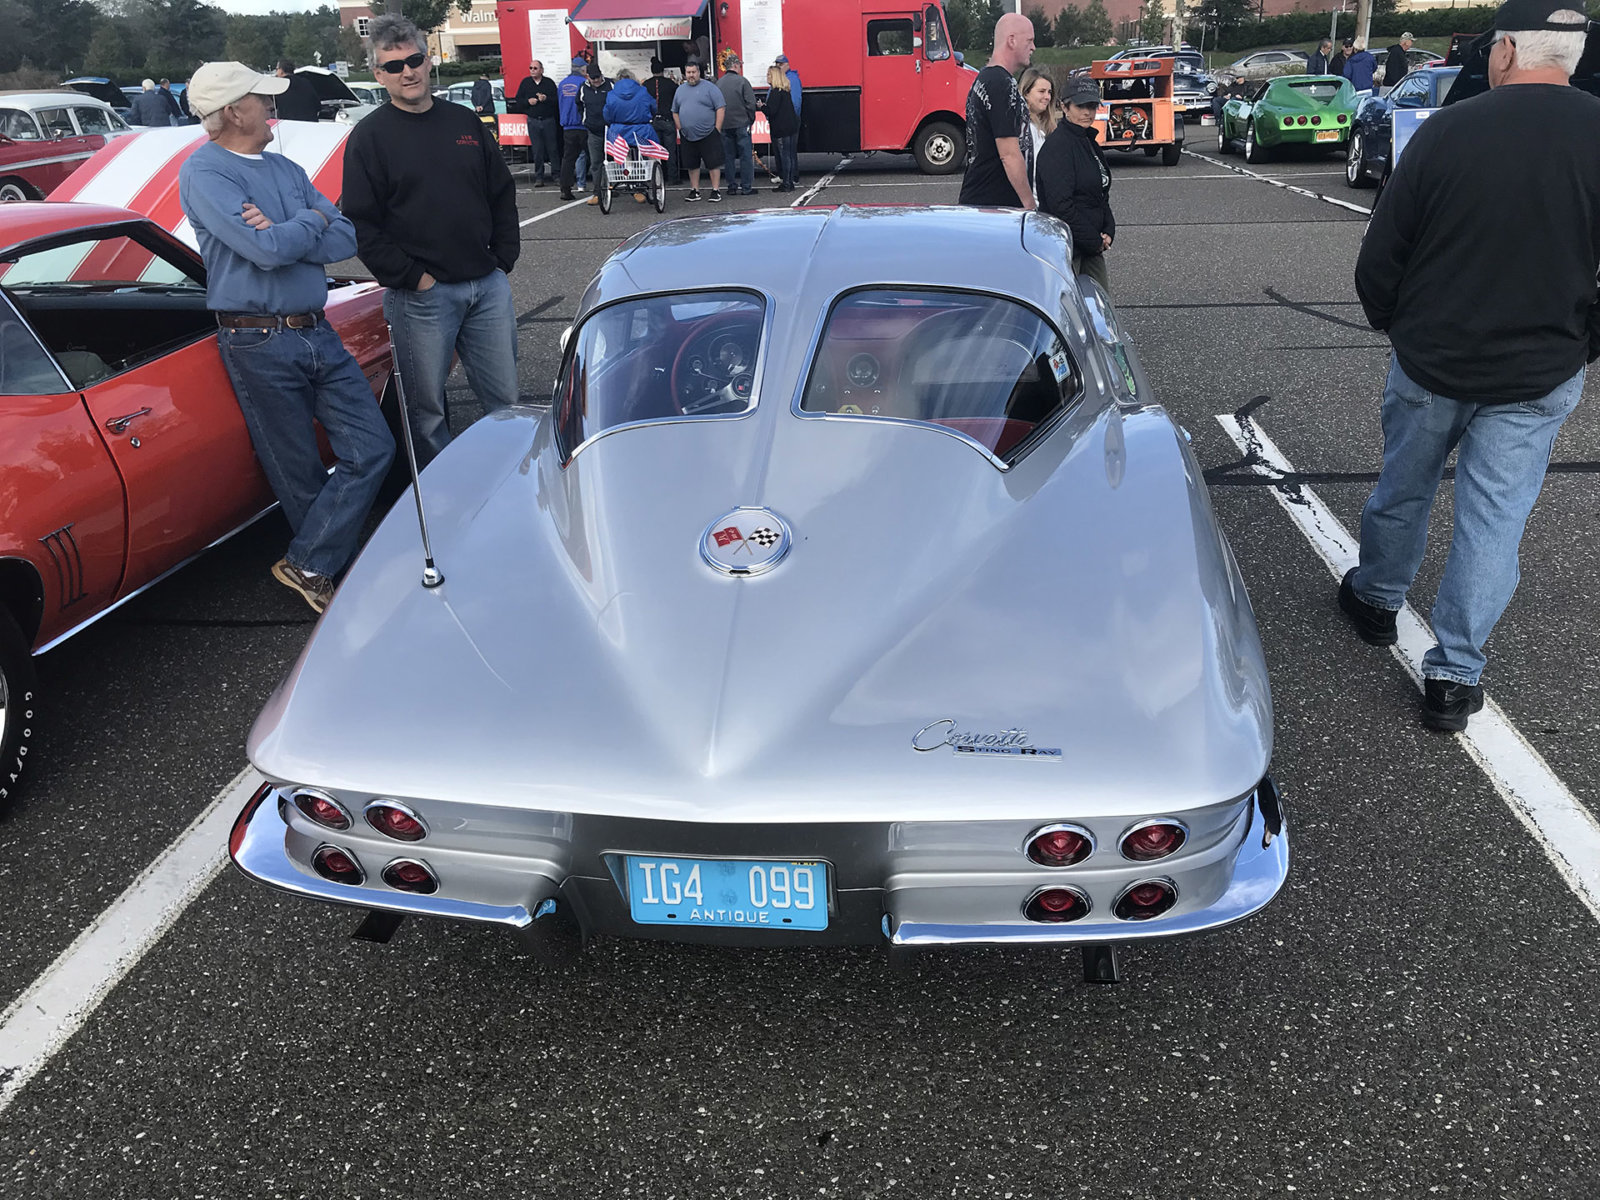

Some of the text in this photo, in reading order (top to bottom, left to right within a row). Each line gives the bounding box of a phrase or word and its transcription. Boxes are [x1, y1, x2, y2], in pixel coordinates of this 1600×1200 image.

[625, 23, 655, 39] Cruzin
[912, 718, 1034, 752] Corvette
[639, 862, 816, 910] IG4 099
[689, 908, 770, 924] ANTIQUE
